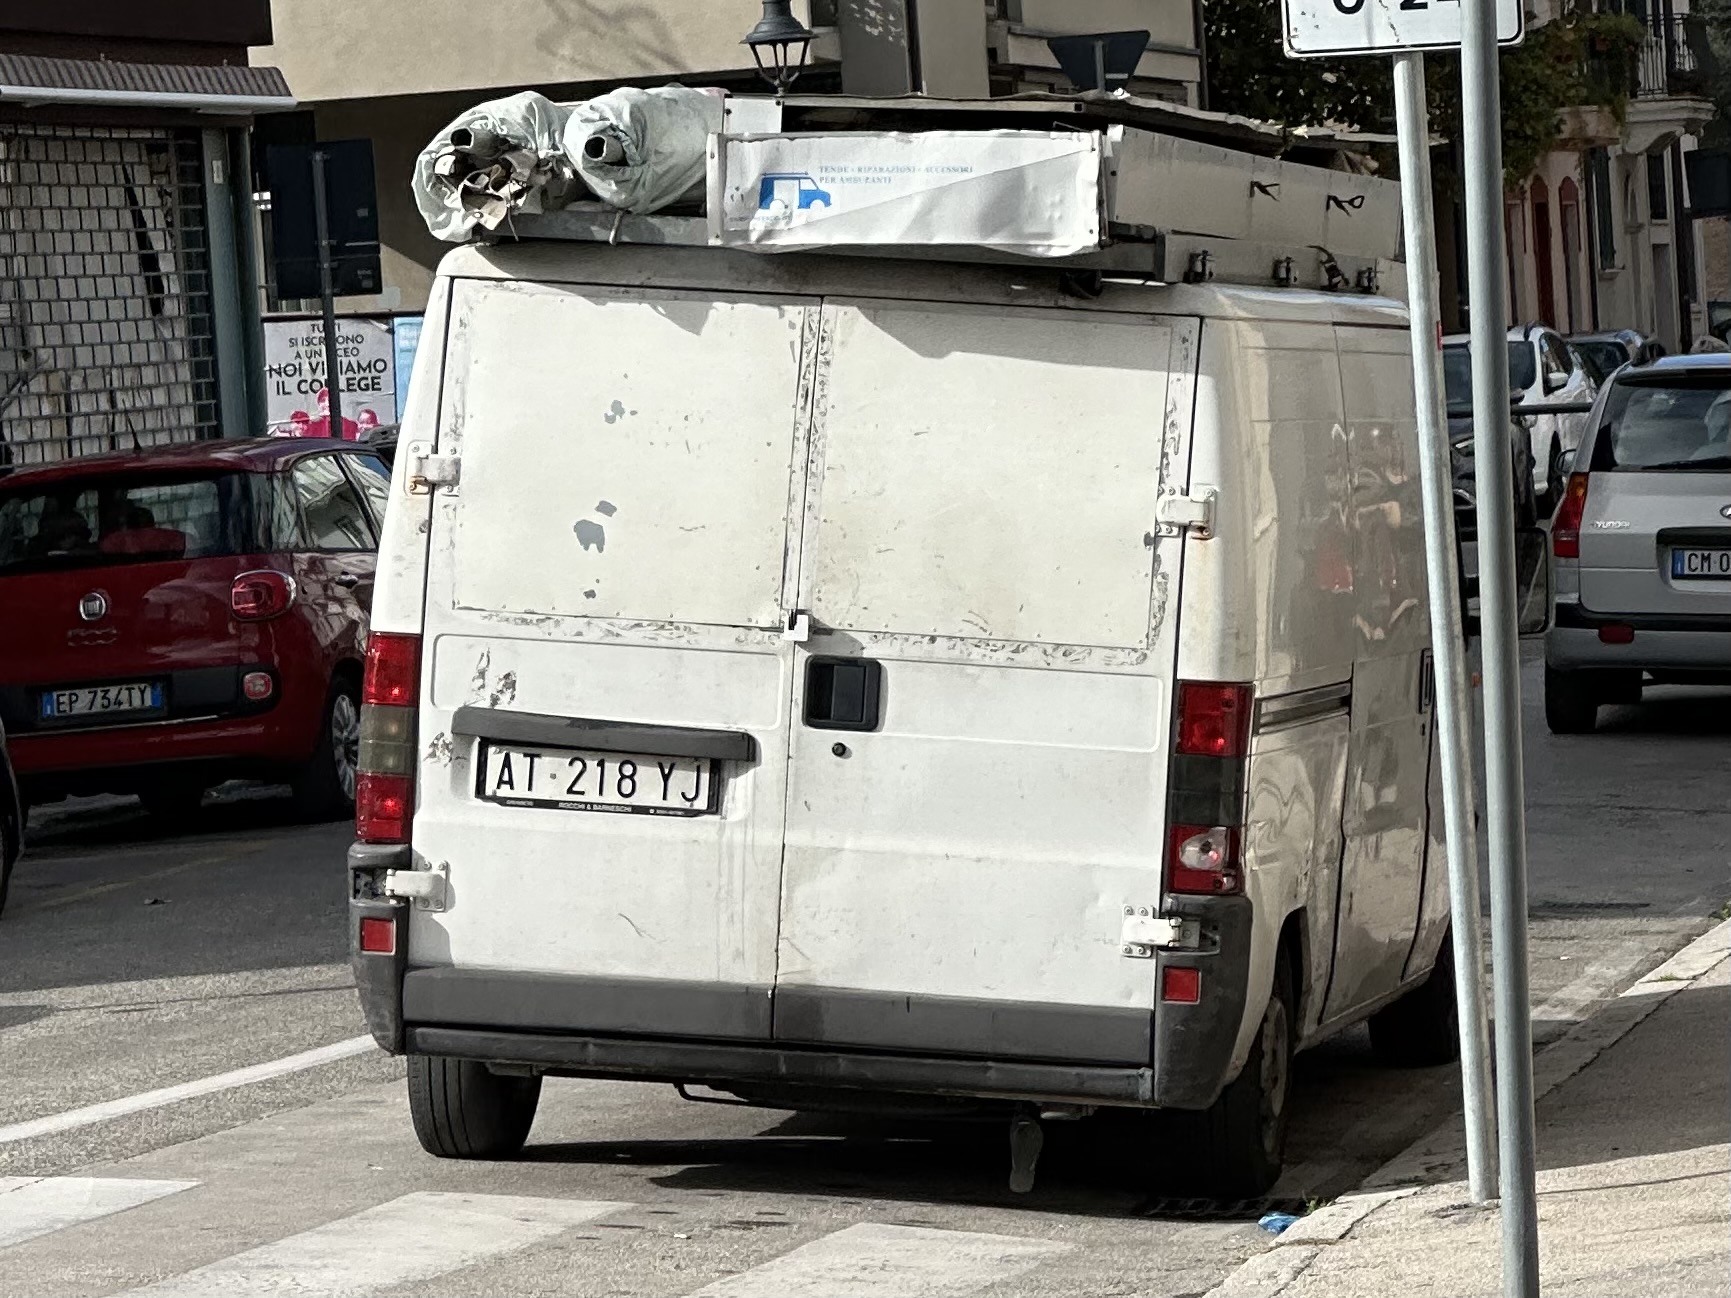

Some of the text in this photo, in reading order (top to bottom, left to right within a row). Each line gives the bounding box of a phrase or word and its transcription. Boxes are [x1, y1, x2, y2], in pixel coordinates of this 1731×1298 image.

[819, 176, 836, 184] PER
[311, 322, 341, 333] TUI
[289, 334, 365, 348] SI ISCRONO
[294, 346, 360, 361] A UN CEO
[268, 358, 387, 379] NOI VIIAMO
[276, 381, 292, 396] IL
[56, 692, 79, 714] EP
[496, 751, 701, 803] AT 218 YJ
